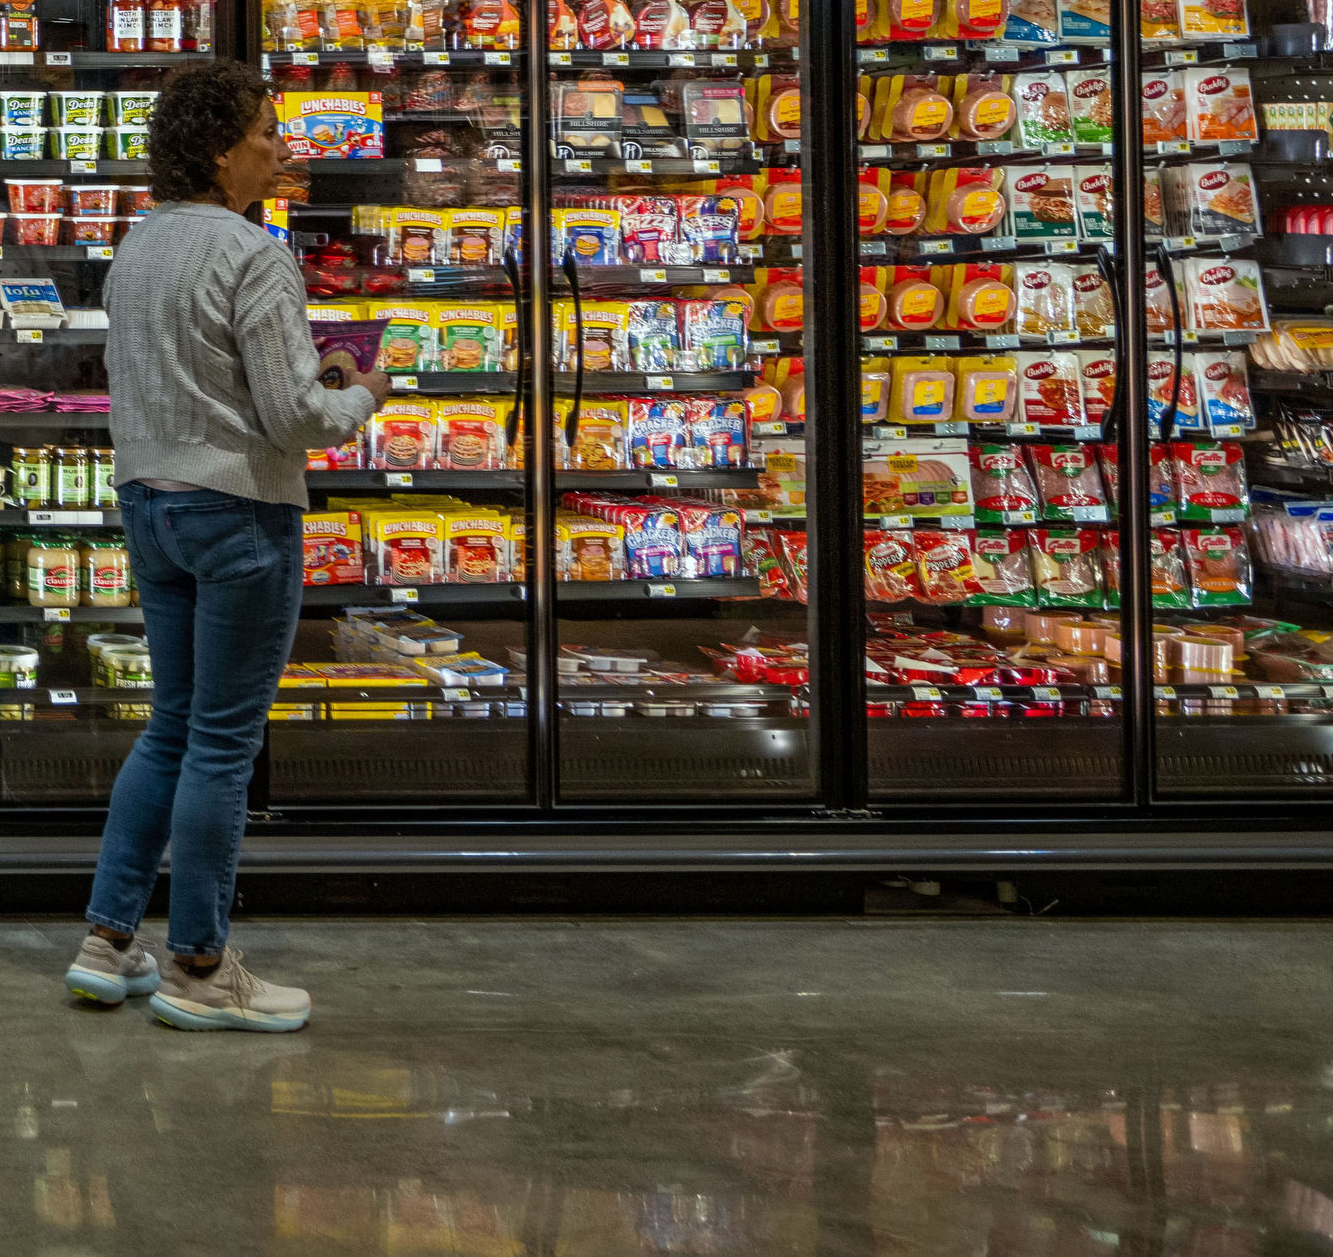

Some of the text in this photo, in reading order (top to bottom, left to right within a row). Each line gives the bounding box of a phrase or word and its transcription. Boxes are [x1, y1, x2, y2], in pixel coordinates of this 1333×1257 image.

[1076, 81, 1105, 93] Buddig
[1200, 78, 1227, 91] Buddig
[301, 99, 366, 115] LUNCHABLES
[289, 142, 308, 150] WIN
[1018, 176, 1048, 189] Buddig
[1201, 174, 1227, 188] Buddig
[397, 212, 442, 225] LUNCHABLES
[452, 212, 498, 224] LUNCHABLES
[5, 285, 40, 300] tofu
[376, 308, 429, 322] LUNCHABLES
[440, 309, 493, 323] LUNCHABLES
[1054, 455, 1082, 468] Gallo
[1194, 452, 1222, 463] Gallo
[383, 519, 438, 537] LUNCHABLES
[1201, 538, 1228, 549] Gallo
[46, 576, 79, 588] claussen
